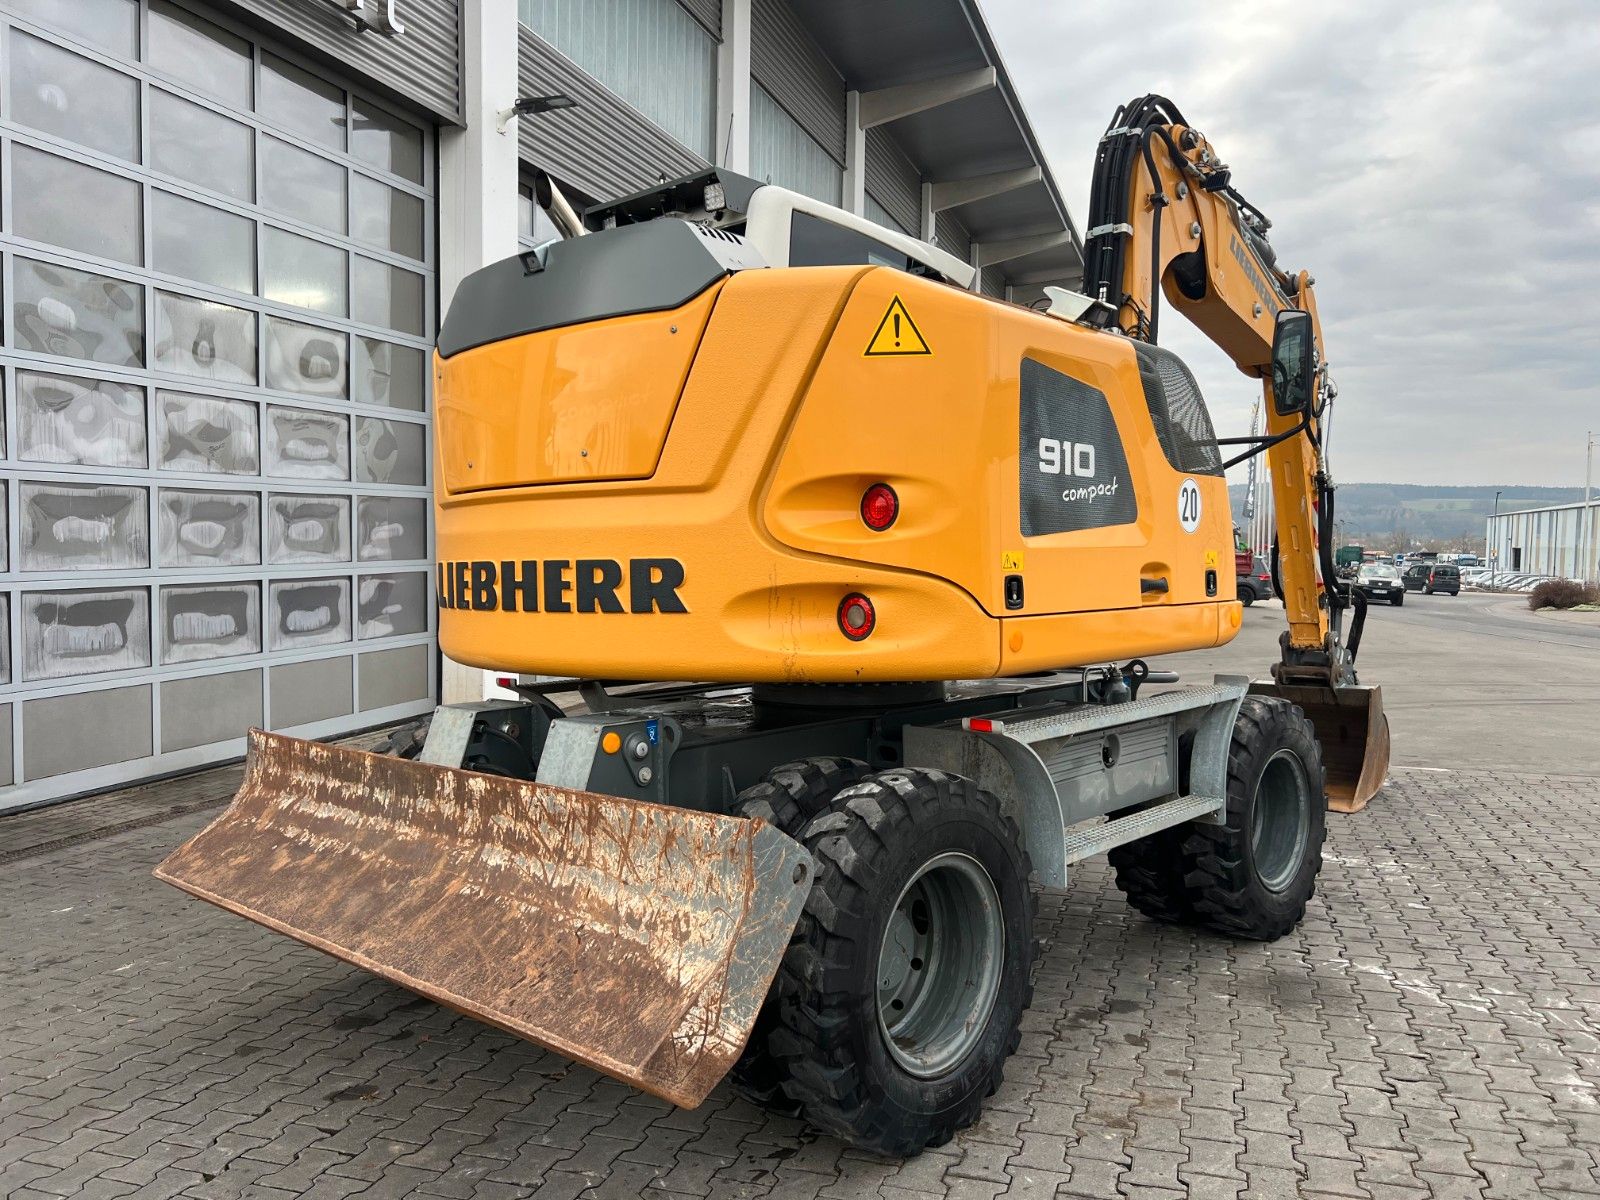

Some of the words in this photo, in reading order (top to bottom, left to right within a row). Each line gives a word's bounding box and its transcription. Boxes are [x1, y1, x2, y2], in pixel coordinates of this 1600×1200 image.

[1039, 438, 1095, 478] 910
[1062, 476, 1118, 504] compact
[1182, 487, 1198, 522] 20
[438, 558, 688, 613] LIEBHERR
